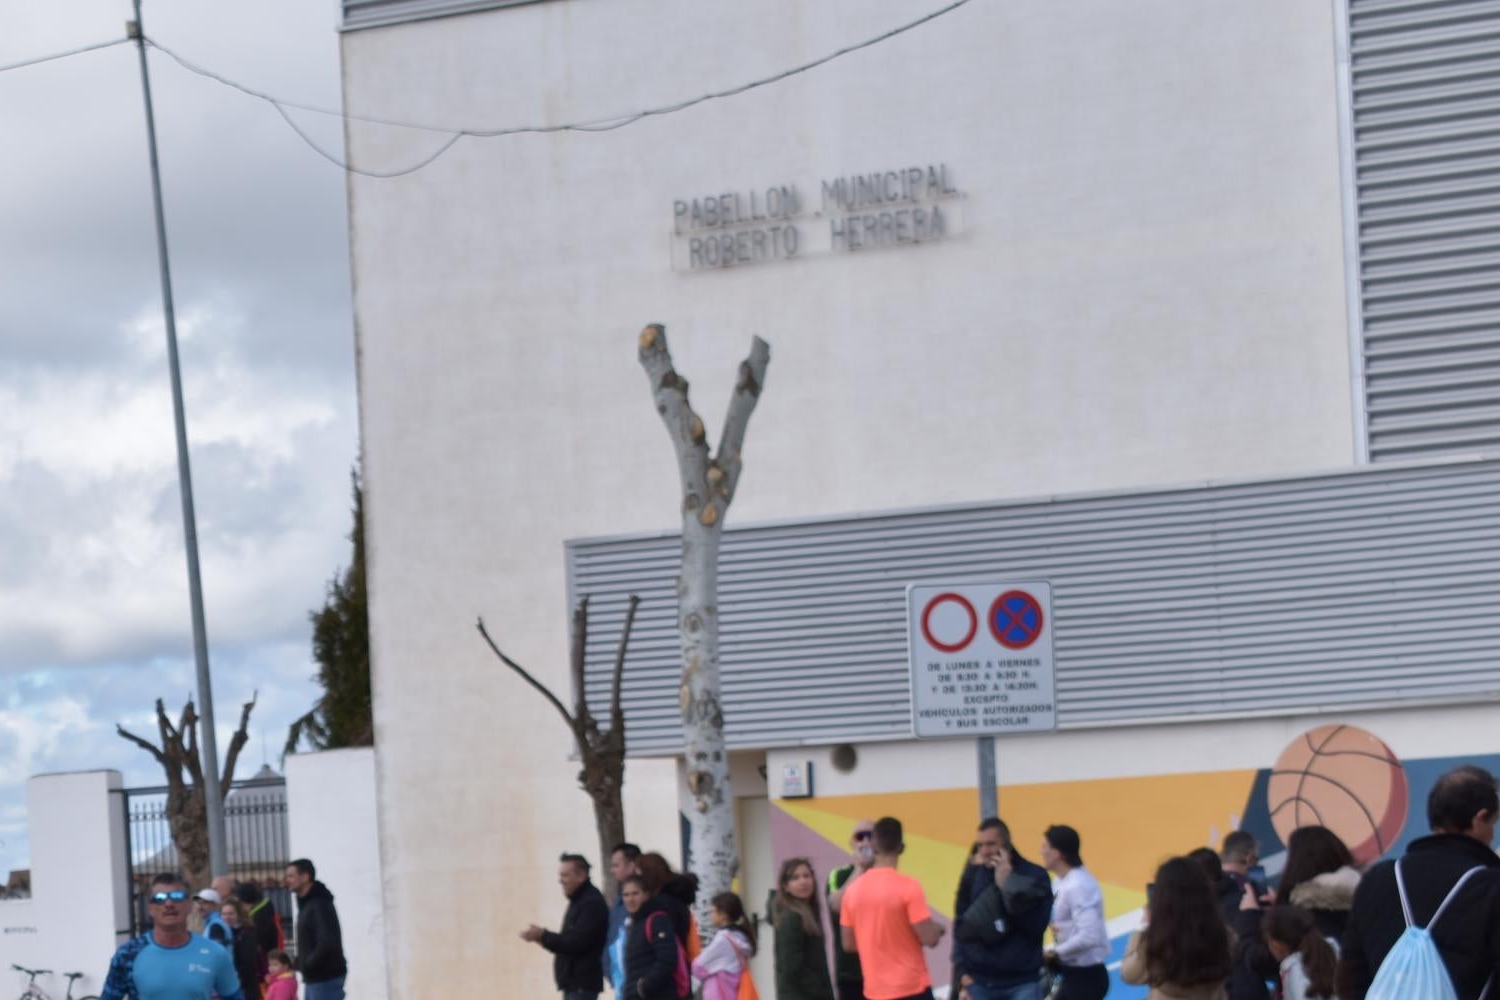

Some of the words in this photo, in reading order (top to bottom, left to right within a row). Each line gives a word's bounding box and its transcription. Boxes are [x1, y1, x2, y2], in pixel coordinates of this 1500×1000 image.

[673, 184, 801, 236] PABELLON
[820, 163, 957, 212] MUNICIPAL
[689, 223, 800, 270] ROBERTO
[829, 205, 947, 252] HERRERA
[927, 662, 940, 672] DE
[946, 661, 980, 670] LUNES
[998, 658, 1040, 668] VIERNES
[938, 673, 951, 682] DE
[984, 671, 991, 680] A
[943, 684, 956, 694] DE
[993, 683, 999, 691] A
[963, 694, 1009, 704] EXCEPTO
[982, 703, 1053, 714] AUTORIZADOS
[945, 719, 951, 727] Y
[957, 718, 977, 728] BUS
[983, 716, 1029, 726] ESCOLAR
